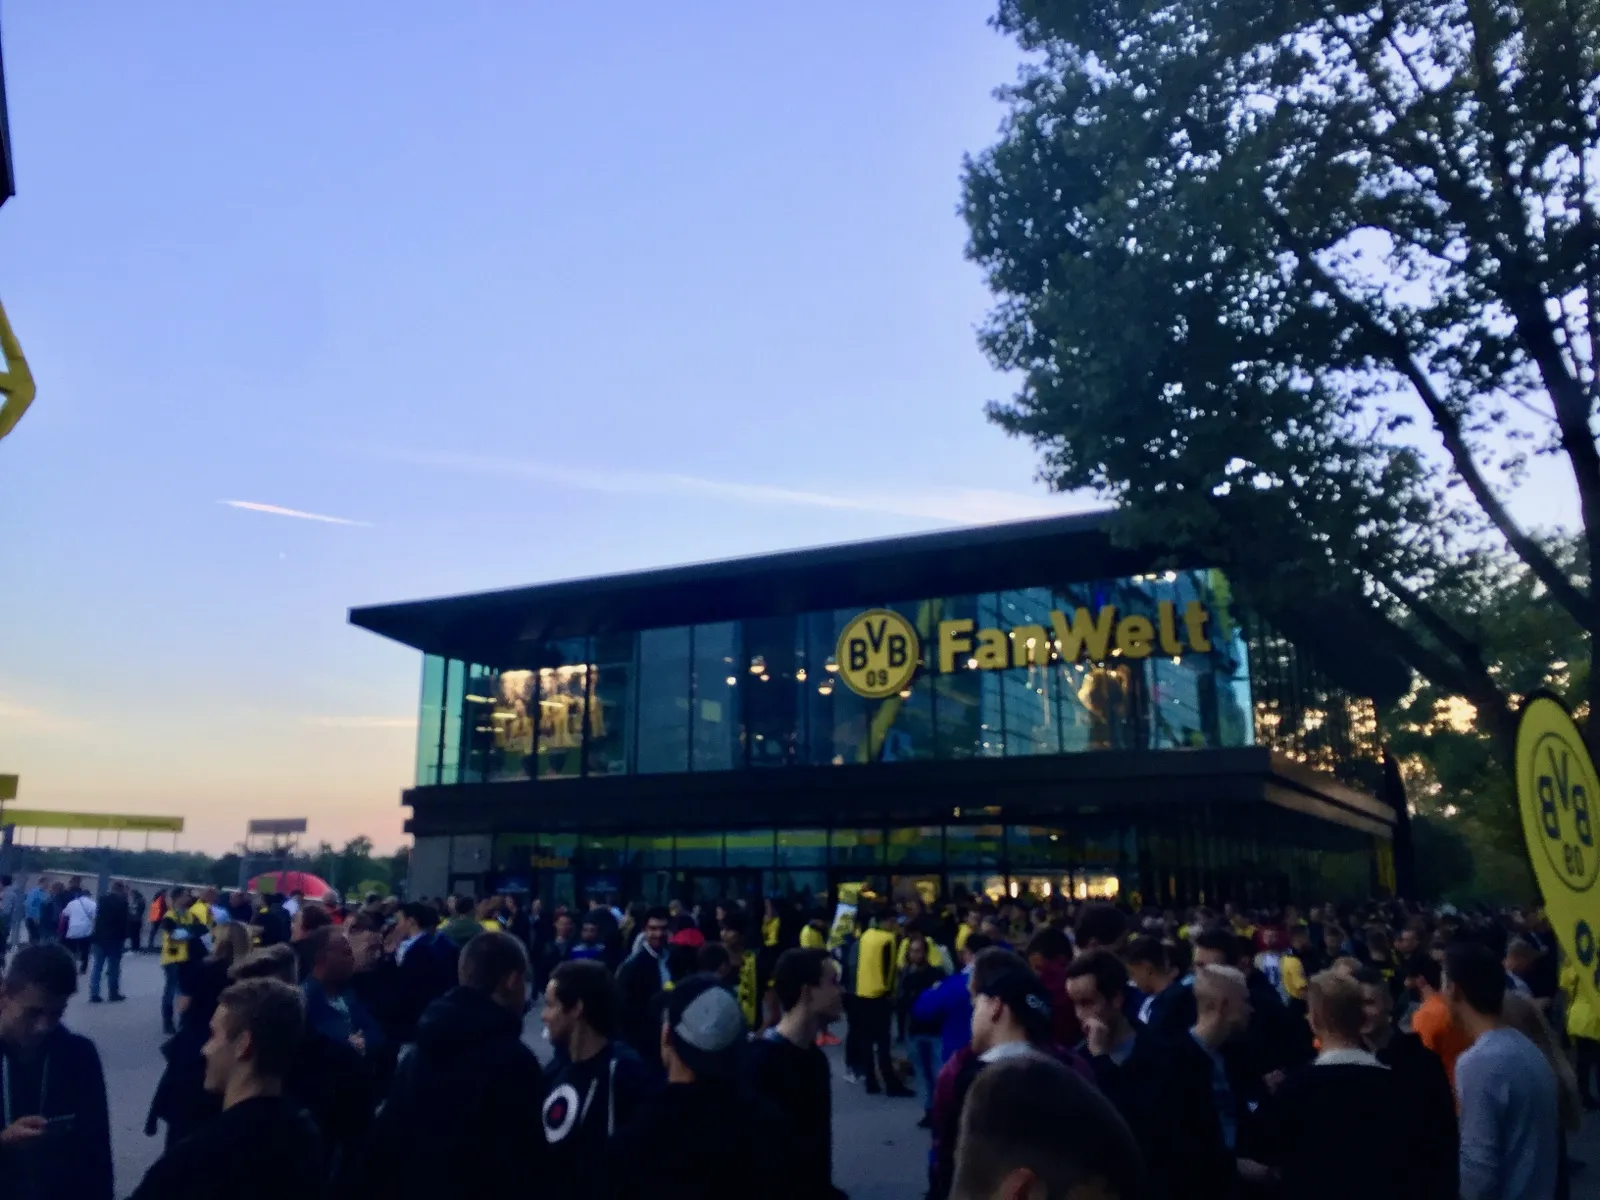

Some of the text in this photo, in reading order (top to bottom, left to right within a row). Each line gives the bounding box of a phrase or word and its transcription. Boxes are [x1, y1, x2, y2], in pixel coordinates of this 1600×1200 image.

[848, 619, 907, 672] BVB
[938, 599, 1212, 673] FanWelt
[865, 669, 888, 687] 09
